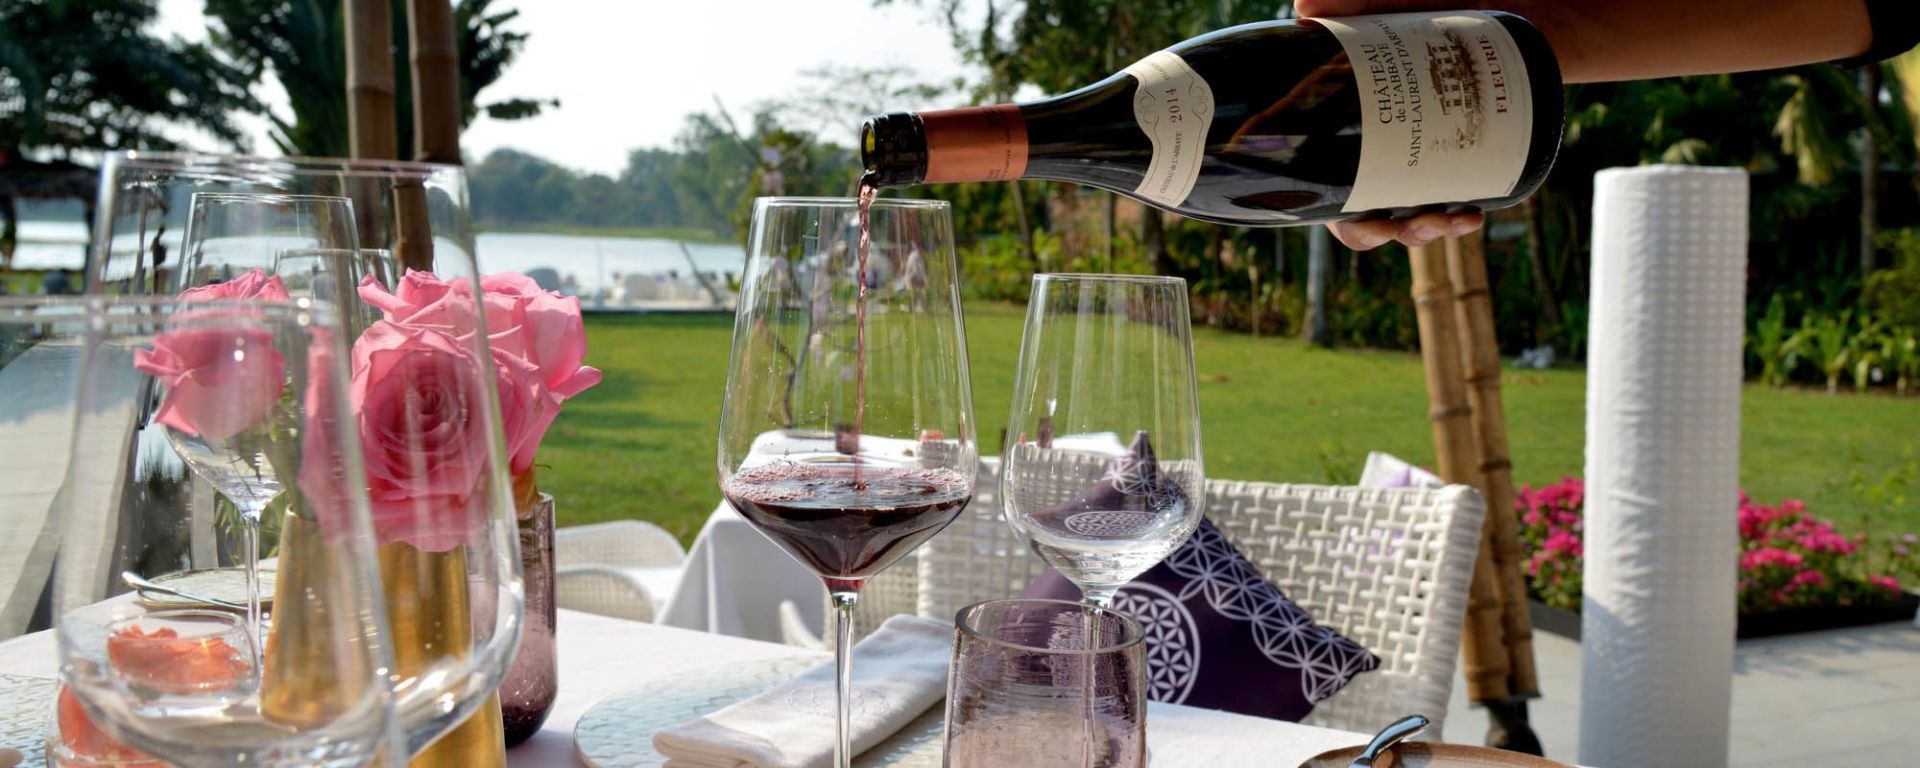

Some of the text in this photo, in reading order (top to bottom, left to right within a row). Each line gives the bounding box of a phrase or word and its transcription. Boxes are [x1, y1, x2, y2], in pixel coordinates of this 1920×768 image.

[1165, 88, 1182, 123] 2014
[1360, 44, 1392, 124] CHÂTEAU
[1377, 43, 1407, 123] de L'ABBAYE
[1402, 60, 1423, 167] SAINT-LAURENT
[1478, 34, 1508, 114] FLEURIE
